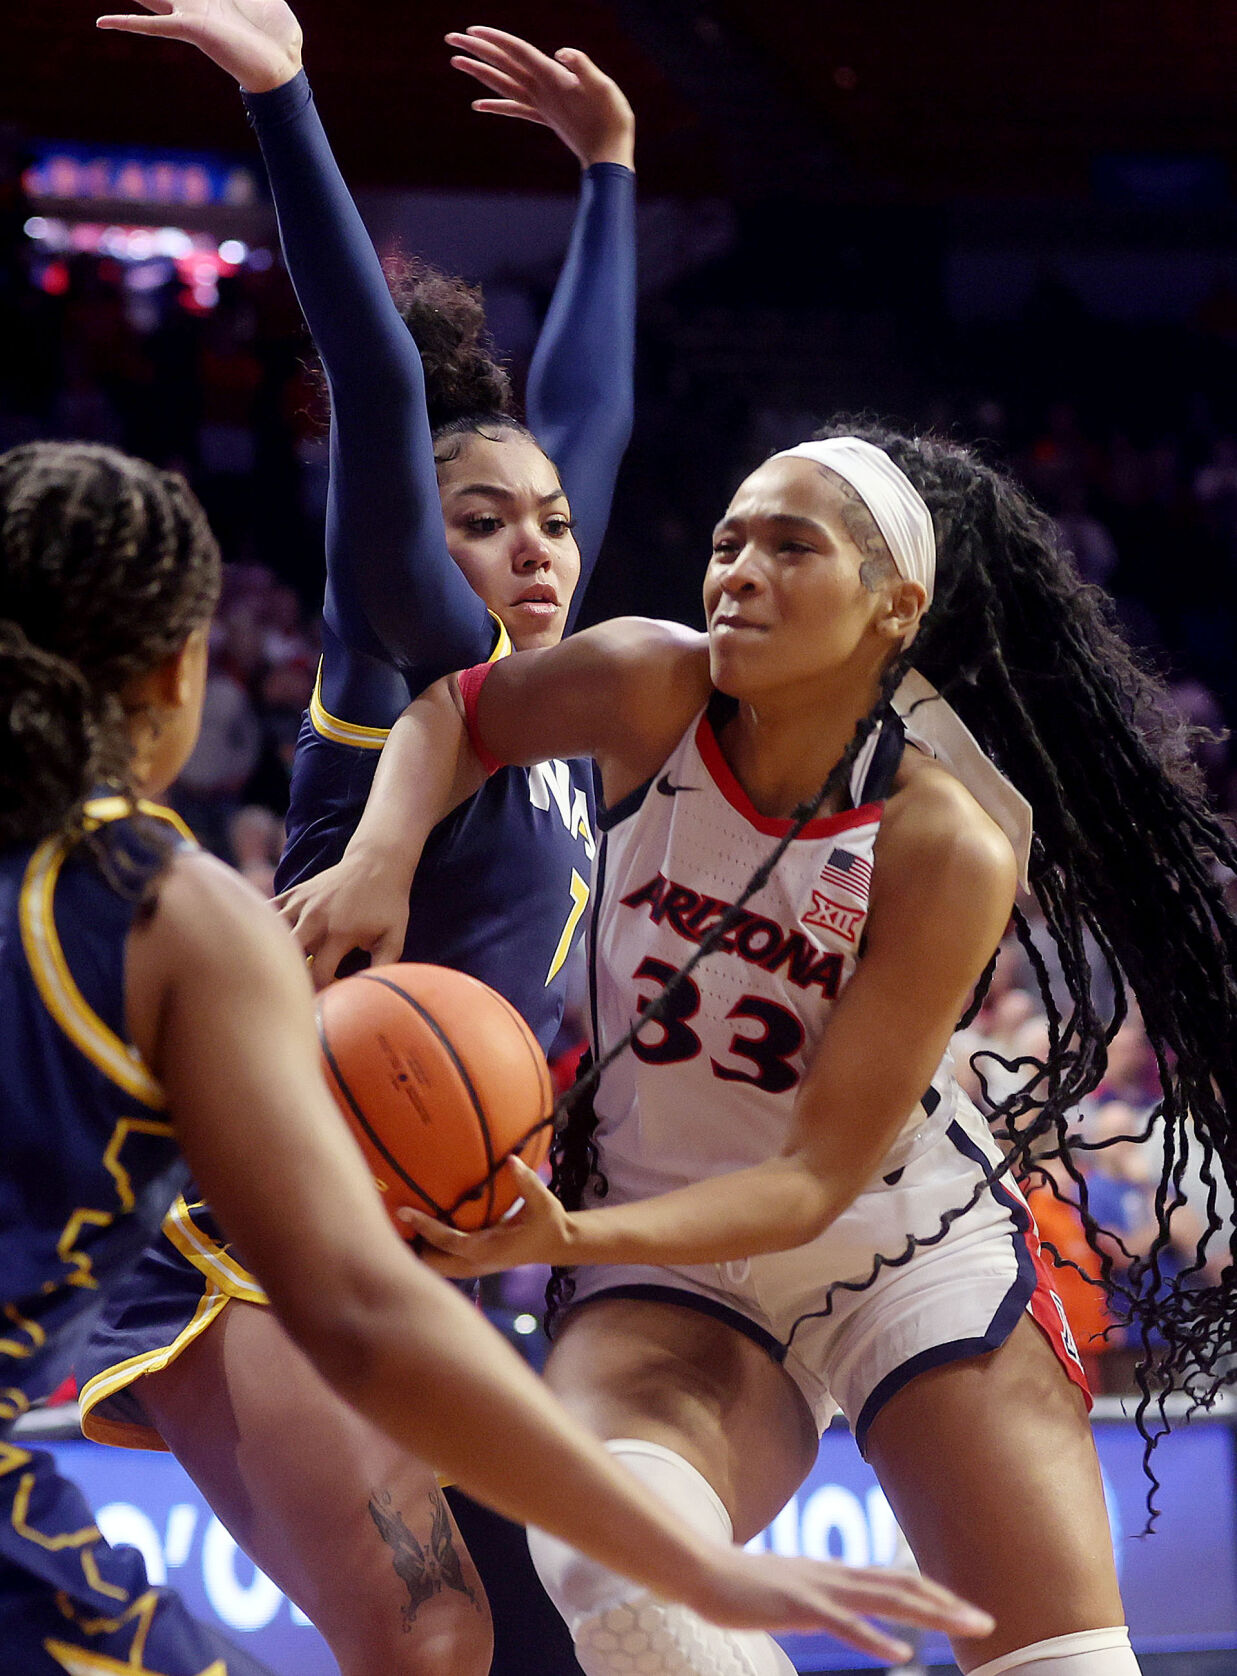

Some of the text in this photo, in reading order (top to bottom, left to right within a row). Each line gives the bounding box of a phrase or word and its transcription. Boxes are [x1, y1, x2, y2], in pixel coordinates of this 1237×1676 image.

[529, 758, 596, 862] NA
[619, 870, 845, 1001] ARIZONA
[801, 889, 866, 943] XII
[630, 956, 806, 1094] 33
